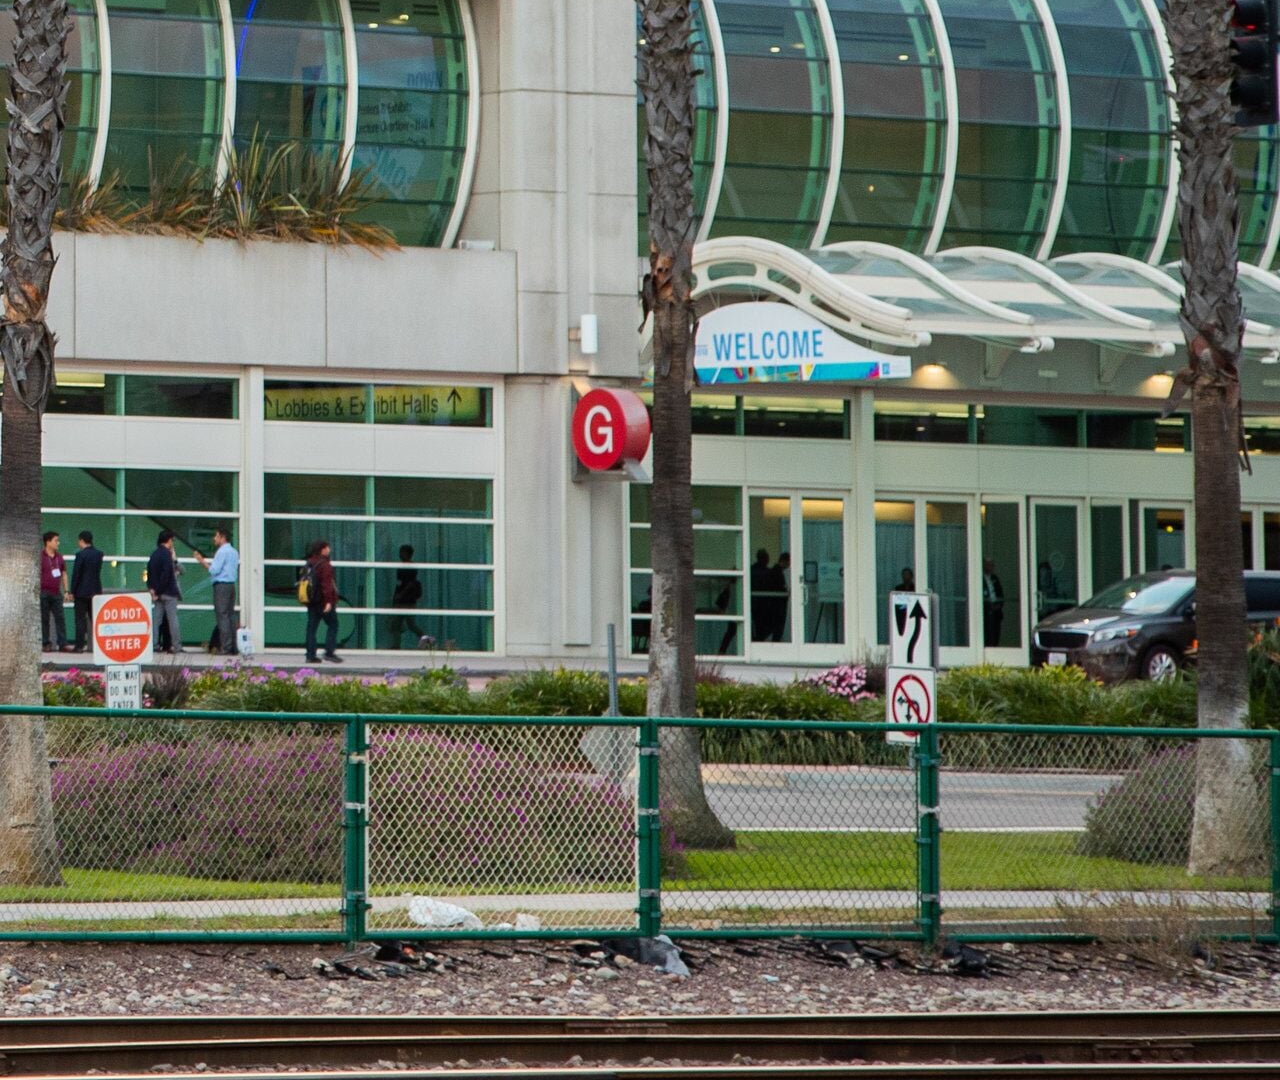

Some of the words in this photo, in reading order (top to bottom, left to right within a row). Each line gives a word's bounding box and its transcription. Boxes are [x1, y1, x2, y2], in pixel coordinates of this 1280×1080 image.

[713, 330, 824, 361] WELCOME
[276, 398, 330, 418] Lobbies
[335, 397, 344, 416] &
[403, 394, 438, 414] Halls
[584, 405, 613, 454] G
[103, 608, 118, 621] DO
[121, 607, 142, 620] NOT
[105, 638, 141, 651] ENTER
[109, 672, 121, 682] ONE
[126, 670, 138, 681] WAY
[110, 686, 119, 697] DO
[124, 686, 137, 697] NOT
